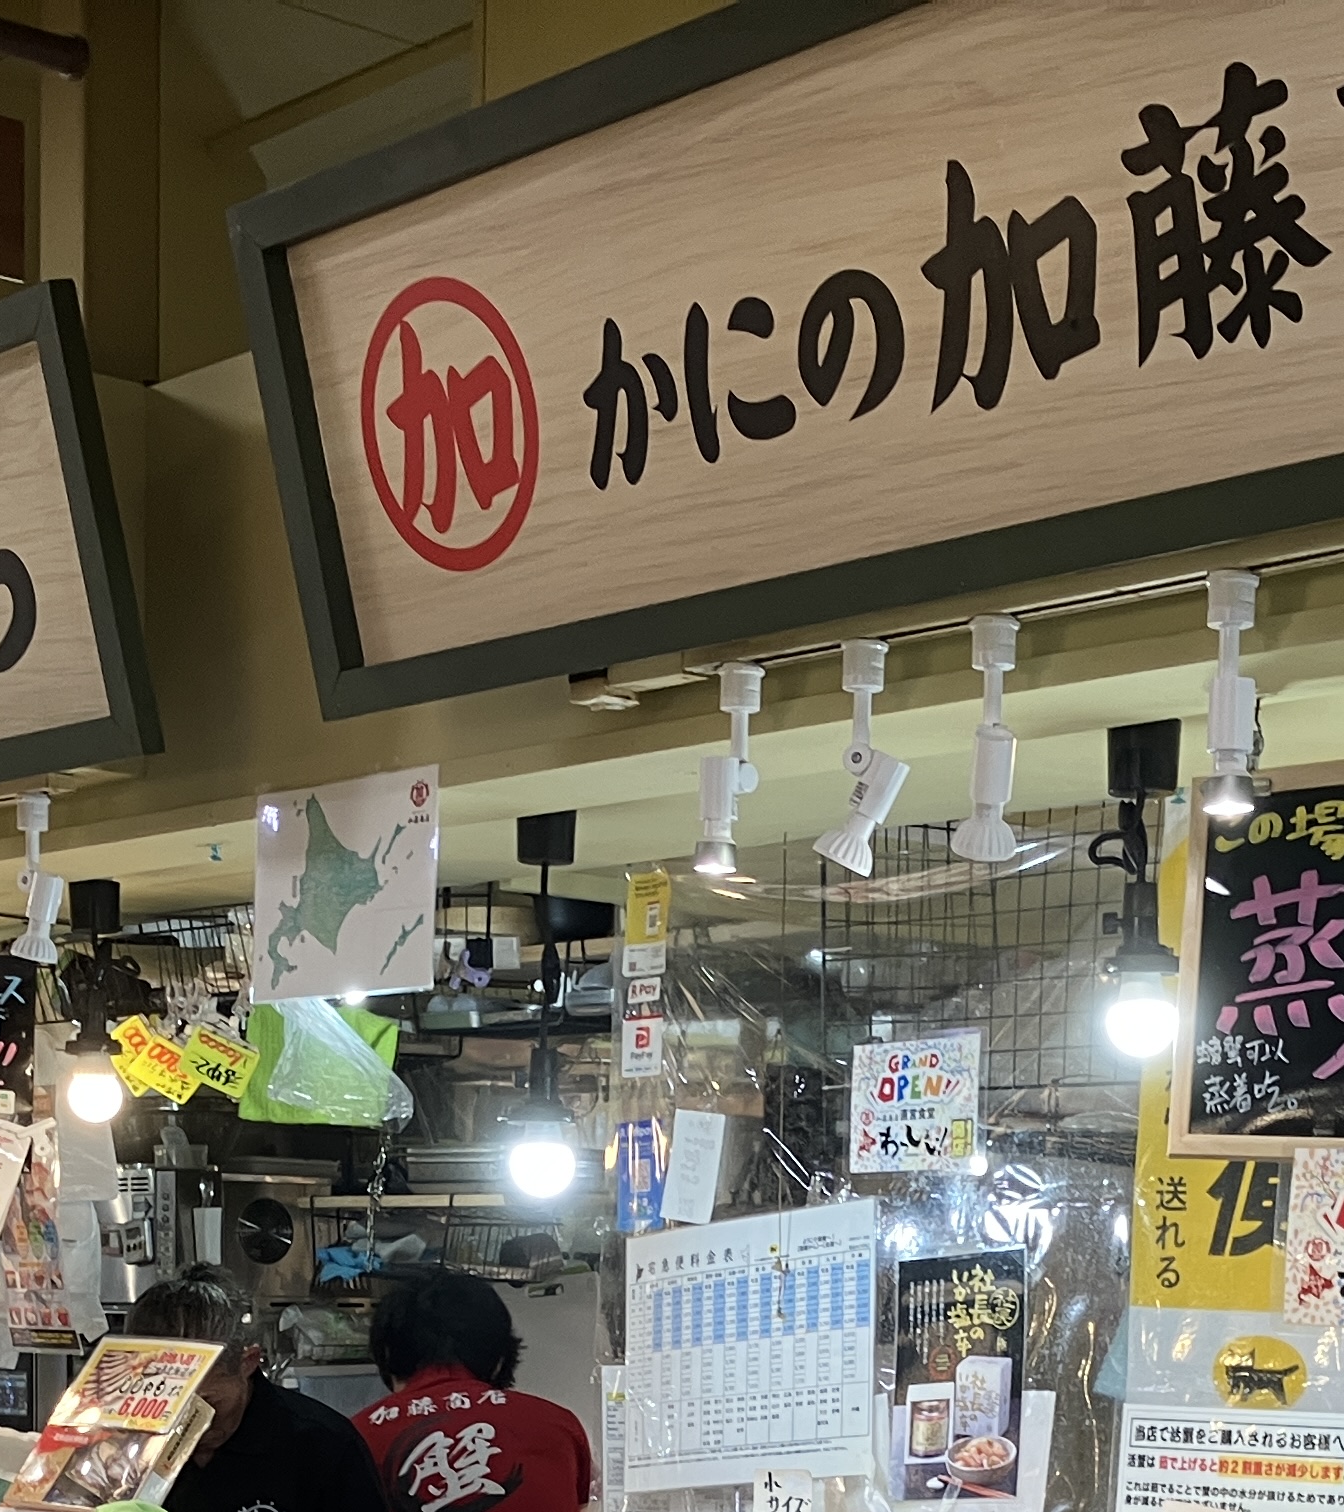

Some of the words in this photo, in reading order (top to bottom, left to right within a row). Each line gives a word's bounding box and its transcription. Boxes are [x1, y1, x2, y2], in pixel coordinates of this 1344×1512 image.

[888, 1053, 940, 1073] GRAND
[369, 1389, 507, 1426] 加藤商店
[763, 1471, 782, 1493] 小
